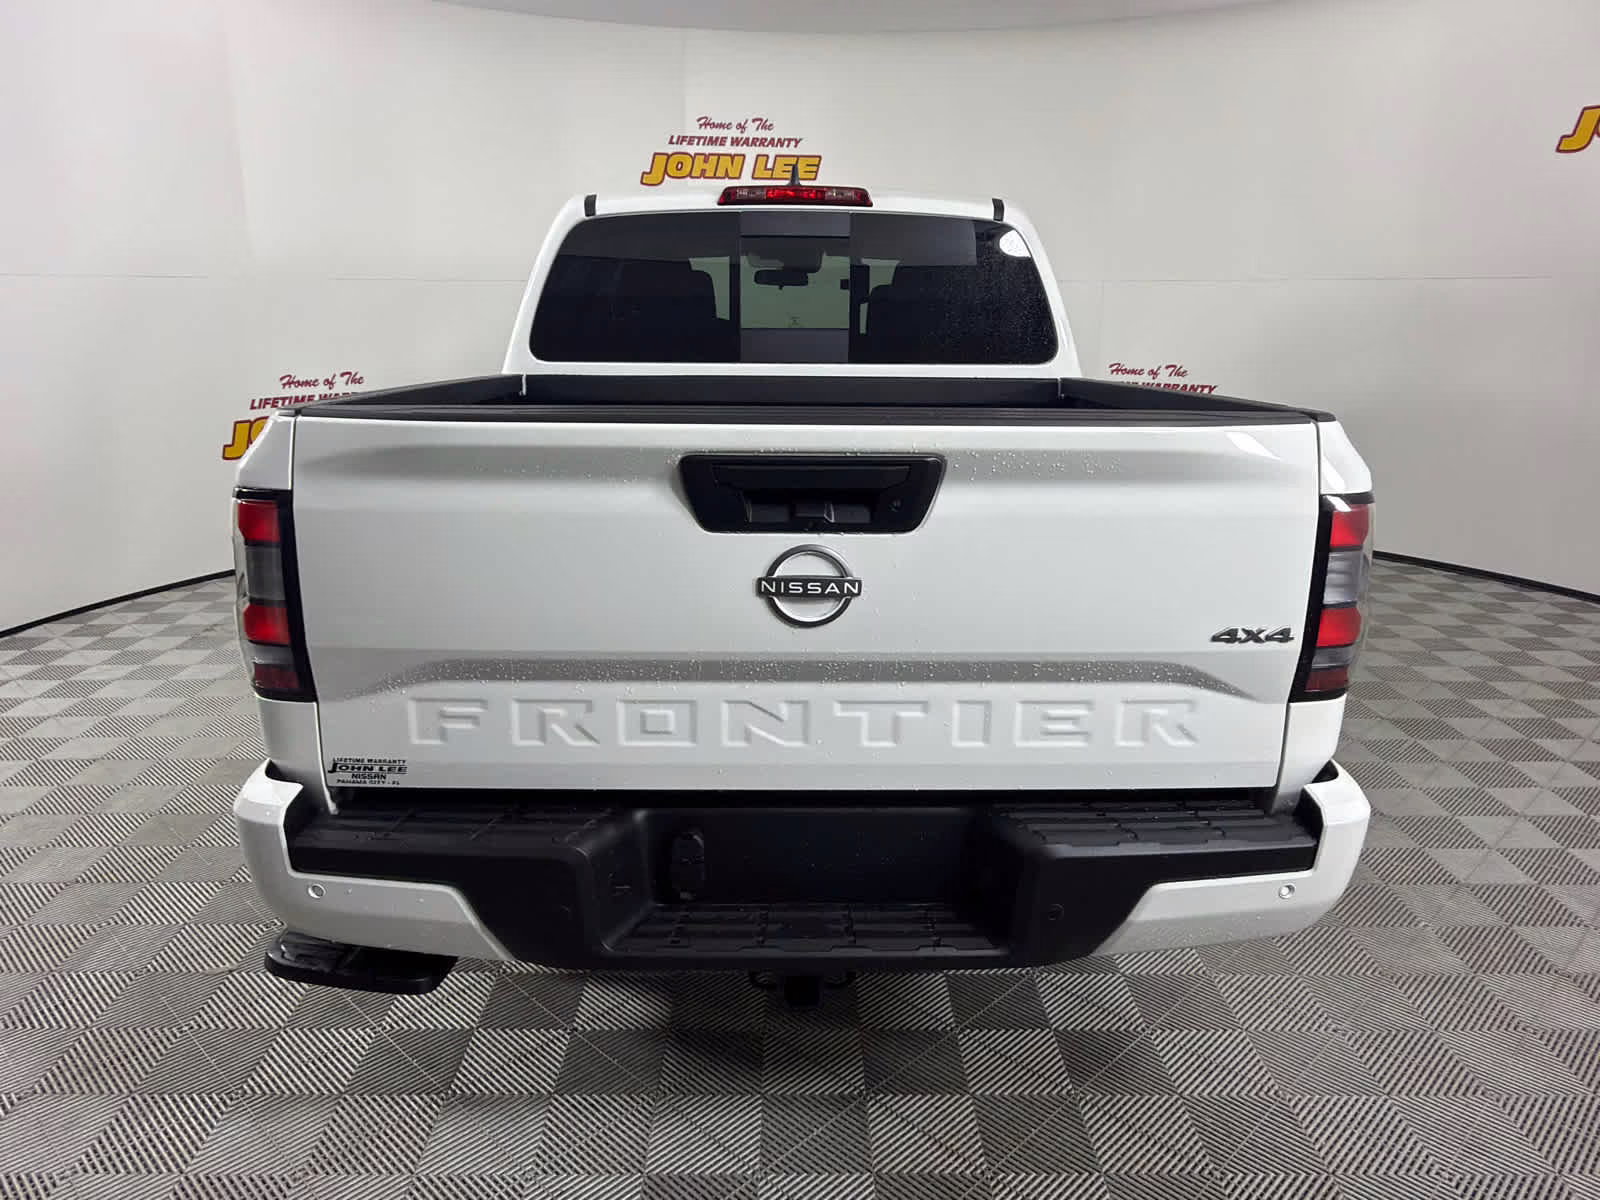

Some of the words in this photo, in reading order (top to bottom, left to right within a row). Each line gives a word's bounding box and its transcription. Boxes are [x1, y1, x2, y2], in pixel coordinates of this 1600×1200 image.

[696, 116, 733, 131] Home
[735, 117, 749, 134] of
[751, 117, 774, 132] The
[668, 135, 728, 147] LIFETIME
[730, 136, 803, 148] WARRANTY
[640, 152, 746, 186] JOHN
[752, 154, 822, 181] LEE
[1108, 362, 1145, 376] Home
[1147, 366, 1161, 380] of
[1165, 364, 1188, 378] The
[279, 374, 320, 389] Home
[323, 374, 336, 390] of
[340, 371, 365, 385] The
[760, 580, 859, 594] NISSAN
[408, 699, 1201, 748] FRONTIER
[328, 762, 374, 773] JOHN
